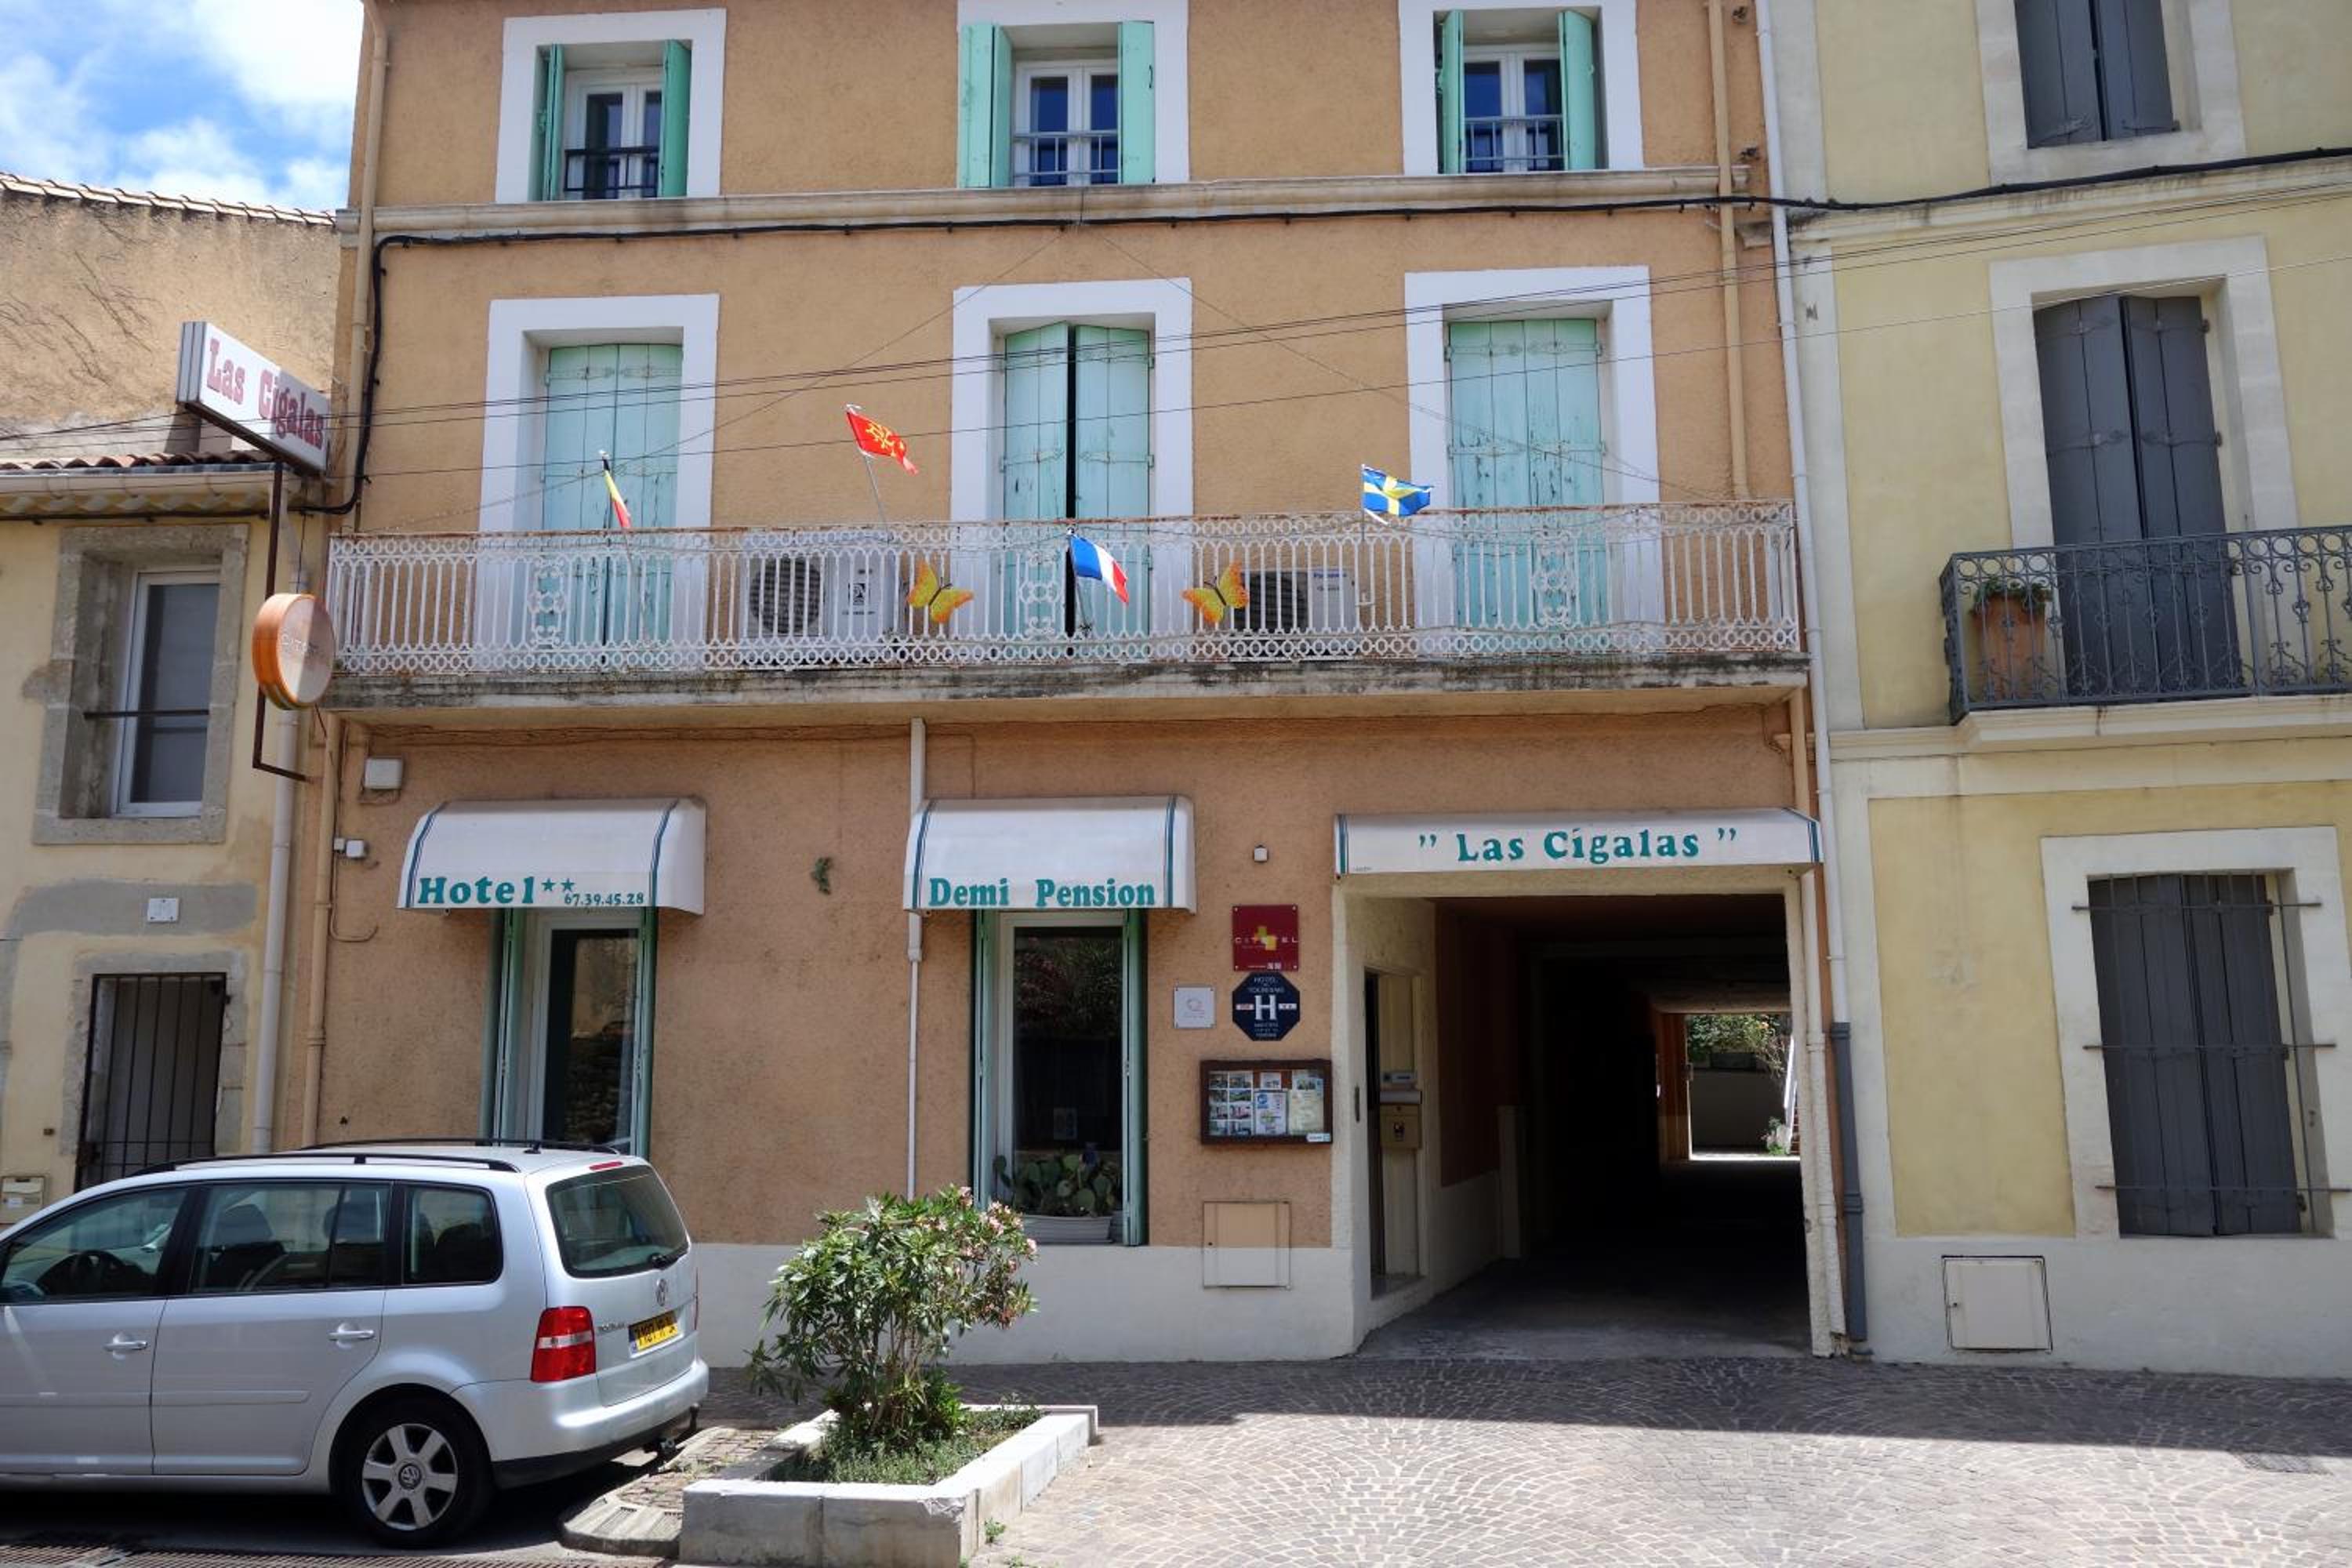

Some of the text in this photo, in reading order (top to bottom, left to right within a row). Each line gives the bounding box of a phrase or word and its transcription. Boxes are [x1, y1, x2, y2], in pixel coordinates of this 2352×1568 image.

[206, 339, 324, 450] Las Cigalas
[1456, 833, 1525, 862] Las
[417, 876, 534, 904] Hotel
[564, 892, 644, 906] 67.39.45.28
[928, 877, 1155, 906] Demi Pension
[1254, 995, 1277, 1020] H
